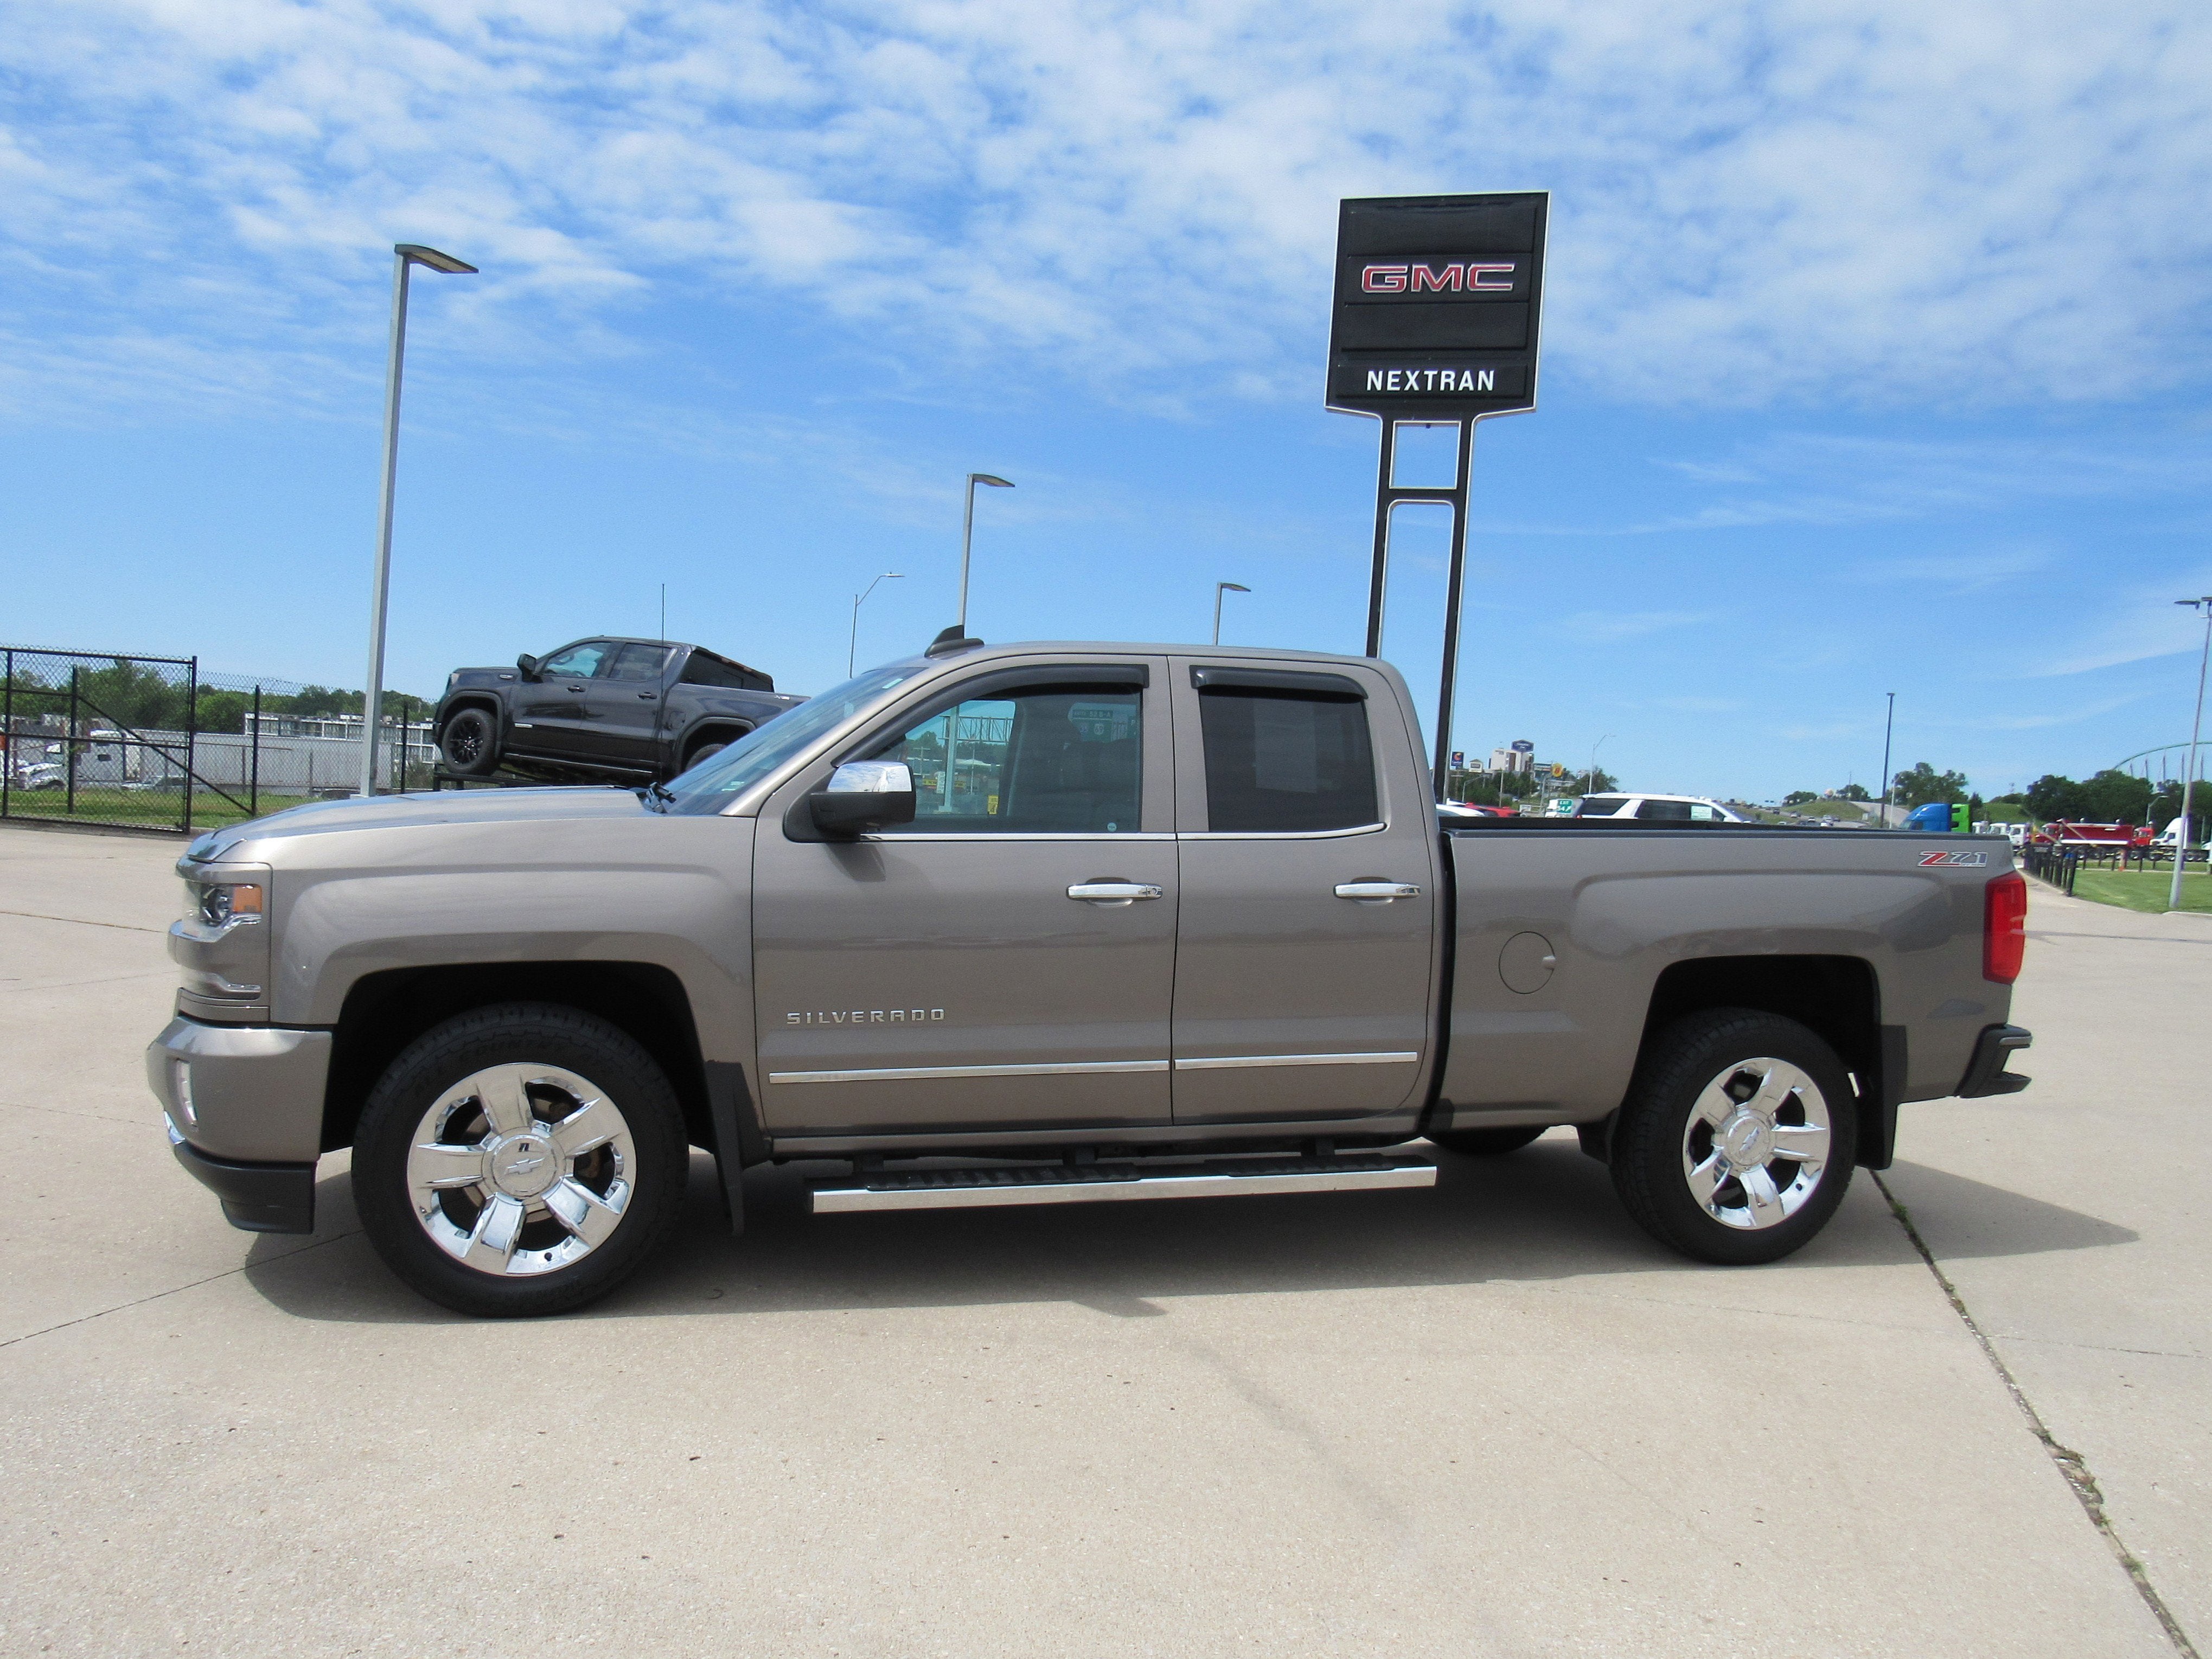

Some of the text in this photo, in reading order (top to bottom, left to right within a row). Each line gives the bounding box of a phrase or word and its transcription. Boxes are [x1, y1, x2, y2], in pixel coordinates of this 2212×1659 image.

[1361, 263, 1515, 293] GMC
[1366, 370, 1495, 391] NEXTRAN
[1917, 851, 1988, 867] Z71
[787, 1008, 945, 1024] SILVERADO
